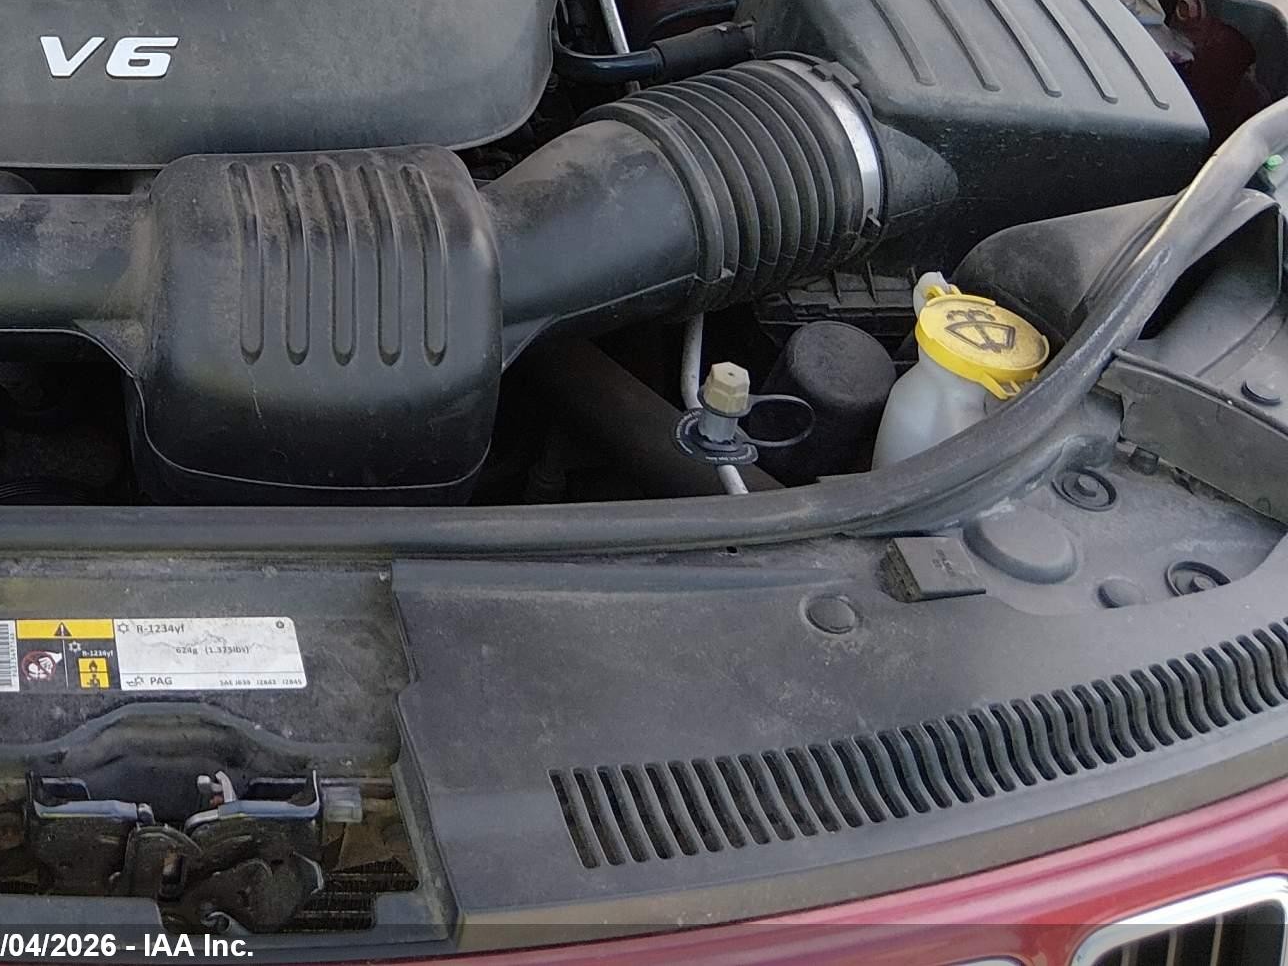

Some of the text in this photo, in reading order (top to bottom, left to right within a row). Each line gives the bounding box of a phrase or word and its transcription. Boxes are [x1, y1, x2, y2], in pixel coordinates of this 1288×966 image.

[39, 36, 180, 78] V6
[136, 624, 185, 634] R-1234yf
[150, 676, 173, 686] PAG
